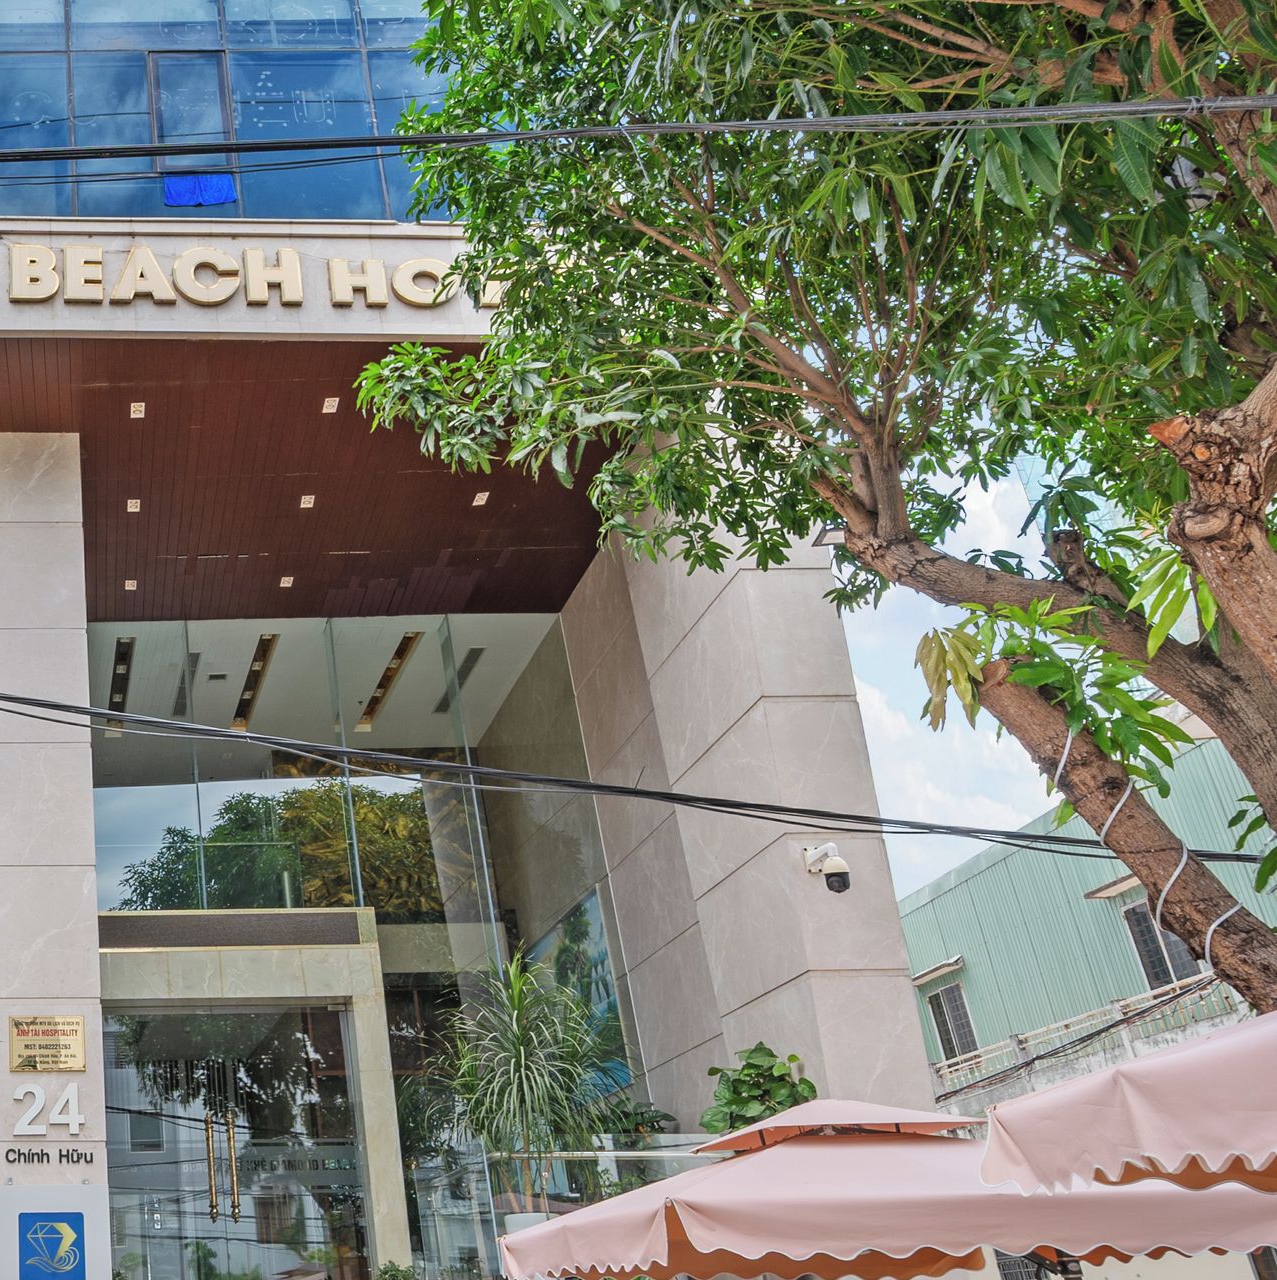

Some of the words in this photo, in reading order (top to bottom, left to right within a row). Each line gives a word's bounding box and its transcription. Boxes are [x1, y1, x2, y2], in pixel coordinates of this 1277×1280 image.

[8, 243, 303, 307] BEACH
[42, 1028, 78, 1036] HOSPITALITY
[13, 1082, 86, 1136] 24
[5, 1148, 51, 1164] Chính
[58, 1148, 94, 1165] Hữu
